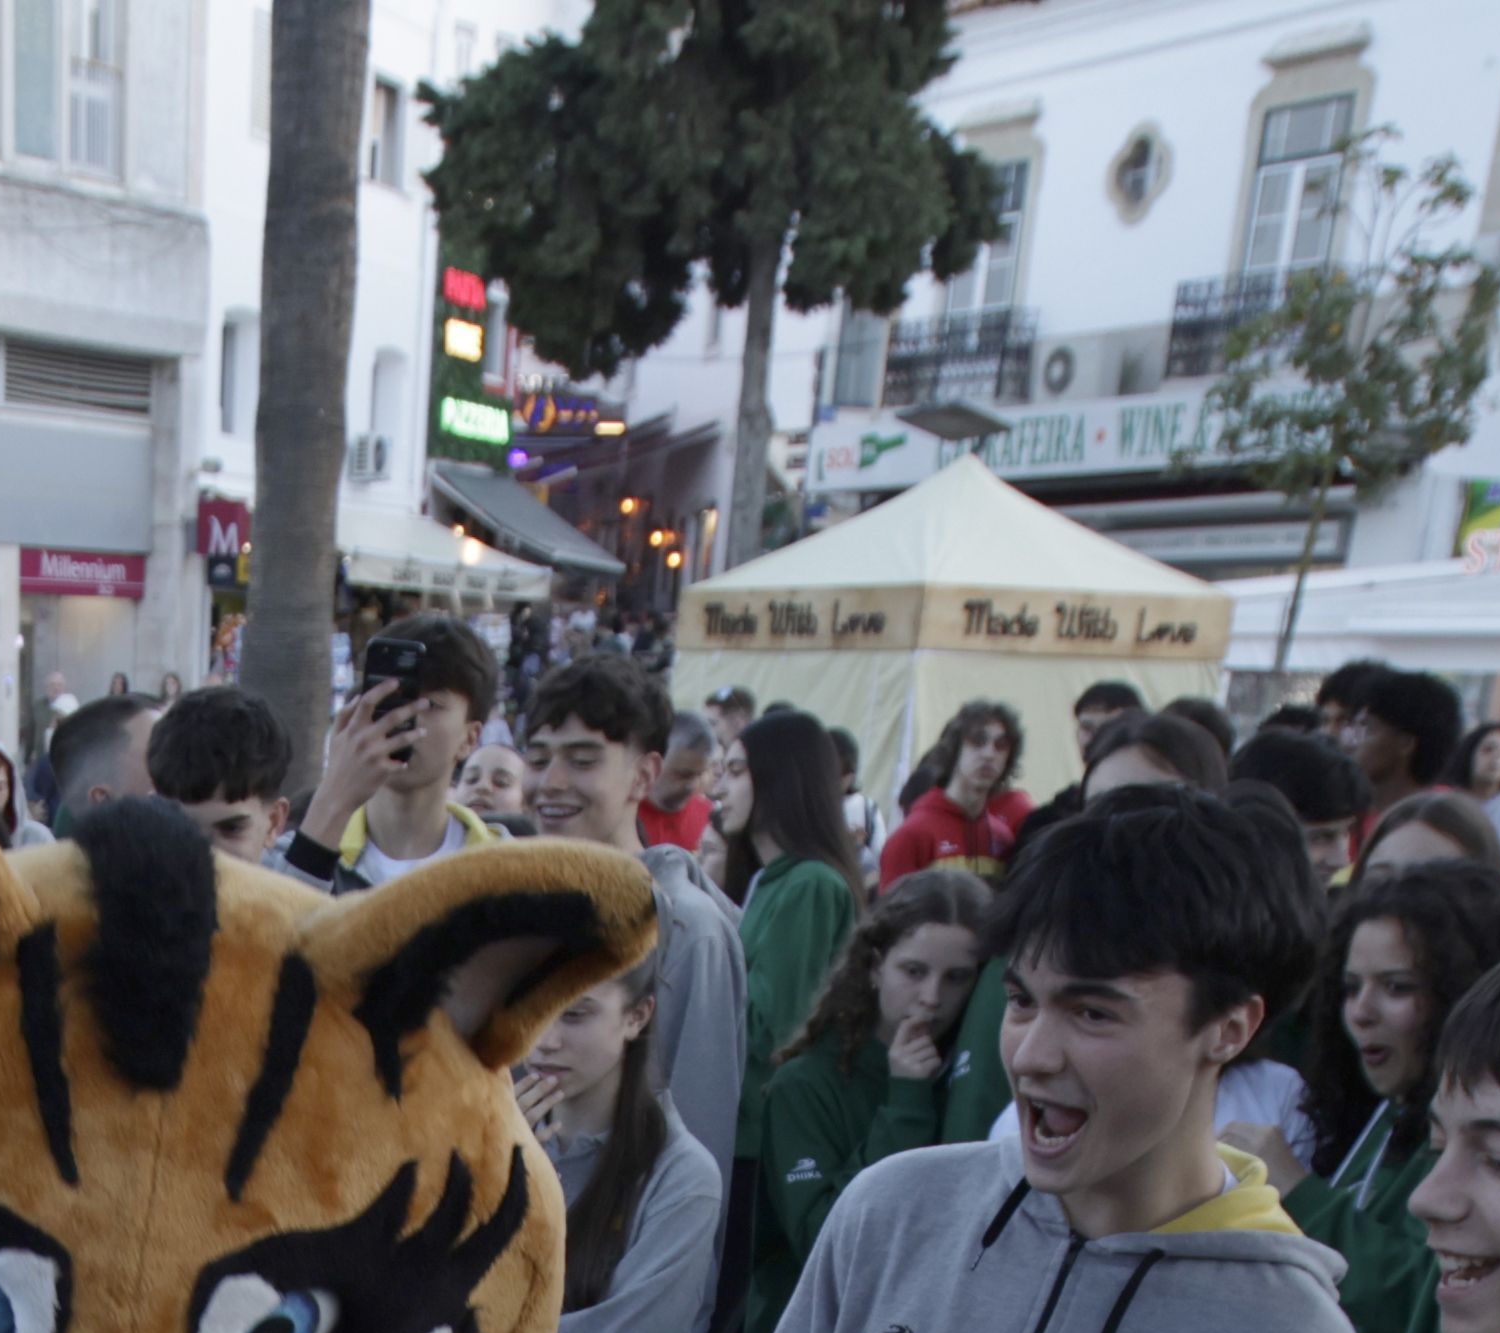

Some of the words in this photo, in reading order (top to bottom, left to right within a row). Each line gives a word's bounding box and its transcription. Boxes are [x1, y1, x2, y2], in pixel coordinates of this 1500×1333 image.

[41, 549, 127, 583] Millennium
[963, 600, 1039, 638] Made
[1135, 607, 1198, 645] Love
